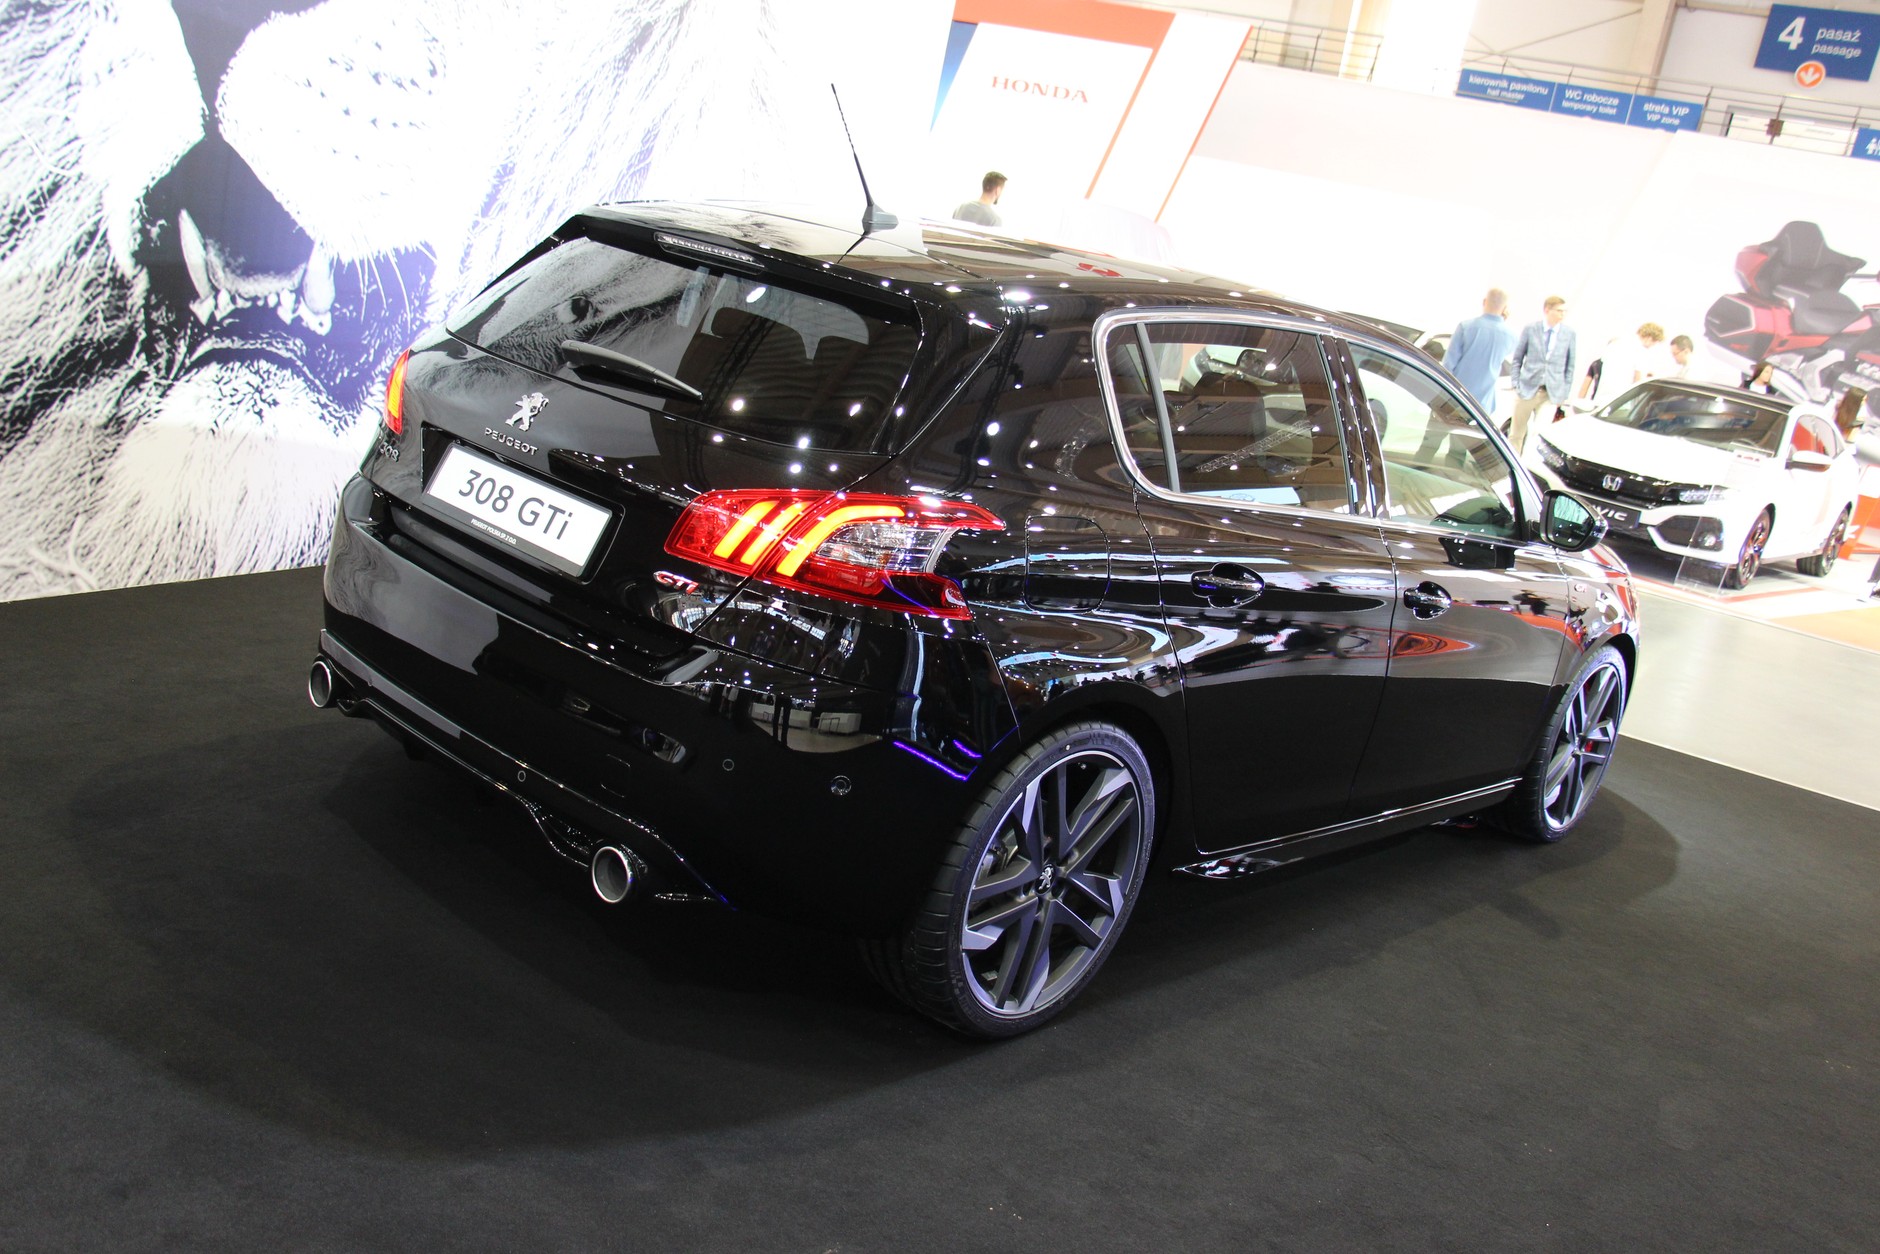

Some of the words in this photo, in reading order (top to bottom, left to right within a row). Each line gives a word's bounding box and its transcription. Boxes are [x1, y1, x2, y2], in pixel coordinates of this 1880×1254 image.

[1777, 16, 1806, 51] 4
[1815, 27, 1862, 43] pasaż
[1811, 43, 1862, 59] passage
[992, 76, 1088, 103] HONDA
[1468, 74, 1508, 89] kierownik
[1509, 82, 1549, 95] pawilonu
[1486, 87, 1500, 97] hall
[1500, 91, 1525, 100] master
[1562, 99, 1598, 114] temporary
[1599, 106, 1617, 115] toilet
[1565, 89, 1582, 100] WC
[1583, 93, 1619, 106] robocze
[1643, 102, 1670, 114] strefa
[1672, 105, 1690, 116] VIP
[1647, 112, 1661, 122] VIP
[1661, 117, 1680, 126] zone
[484, 427, 538, 456] PEUGEOT
[379, 441, 400, 462] 308
[458, 469, 514, 514] 308
[518, 497, 573, 540] GTi
[653, 570, 699, 595] GTi
